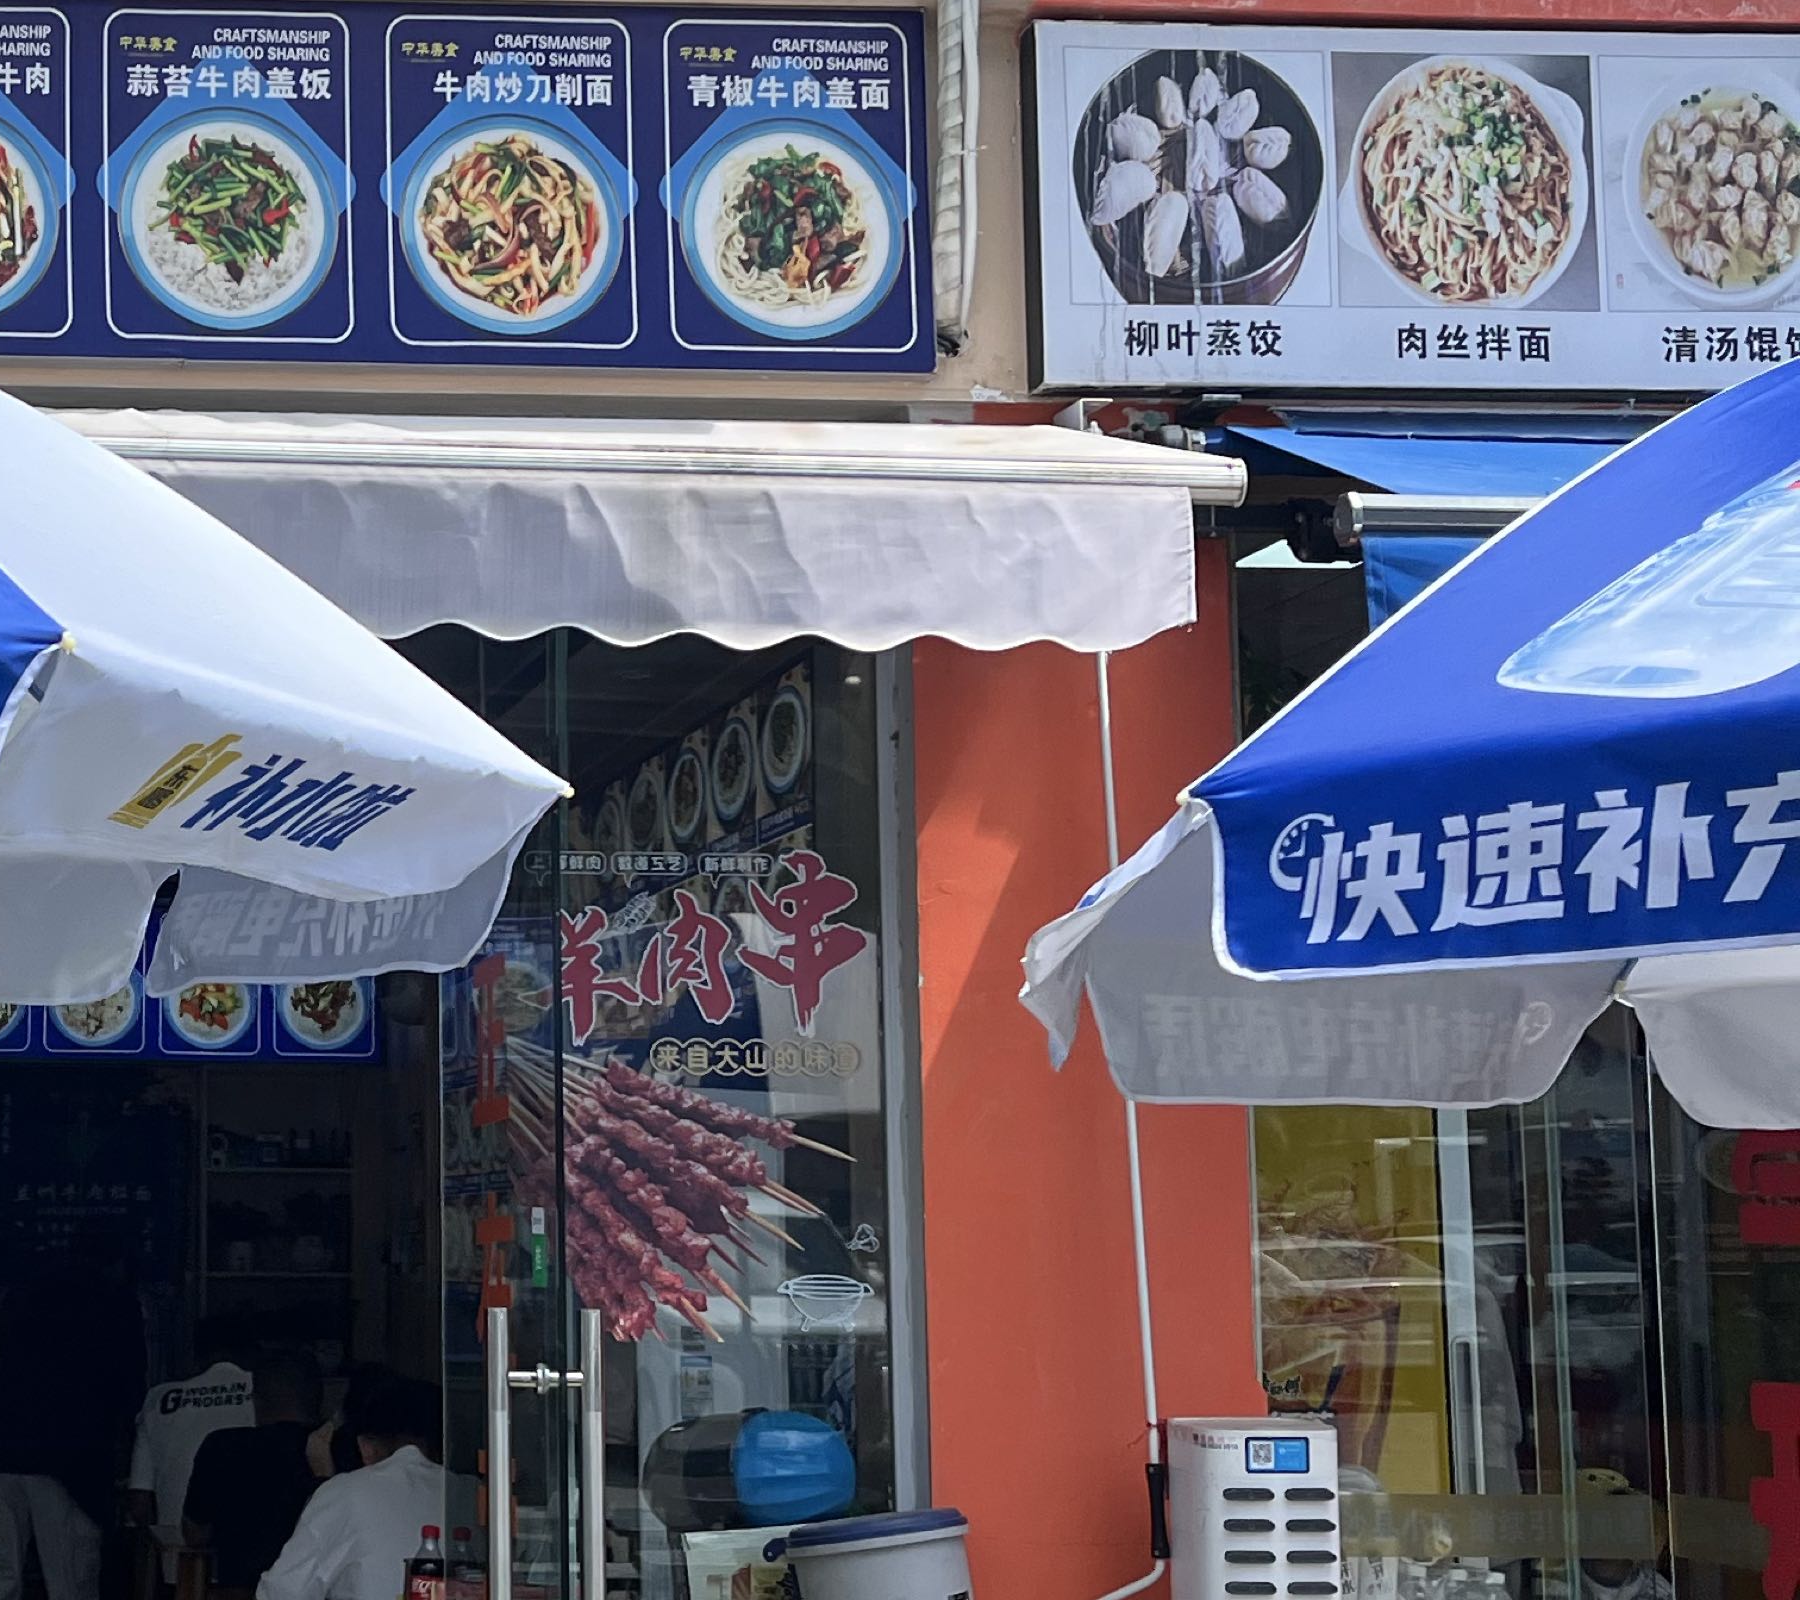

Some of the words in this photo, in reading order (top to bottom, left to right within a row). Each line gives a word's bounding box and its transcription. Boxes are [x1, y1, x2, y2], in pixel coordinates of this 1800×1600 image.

[213, 28, 332, 45] CRAFTSMANSHIP
[494, 34, 613, 51] CRAFTSMANSHIP
[191, 44, 223, 60] AND
[225, 46, 265, 61] FOOD
[267, 46, 331, 63] SHARING
[772, 38, 890, 55] CRAFTSMANSHIP
[473, 50, 505, 66] AND
[507, 51, 547, 67] FOOD
[549, 52, 613, 69] SHARING
[751, 55, 782, 70] AND
[785, 55, 824, 71] FOOD
[826, 56, 890, 72] SHARING
[126, 64, 333, 101] 蒜苔牛肉盖饭
[432, 71, 614, 107] 牛肉炒刀削面
[687, 73, 891, 111] 青椒牛肉盖面
[1123, 318, 1284, 359] 柳叶蒸饺
[1397, 324, 1552, 363] 肉丝拌面
